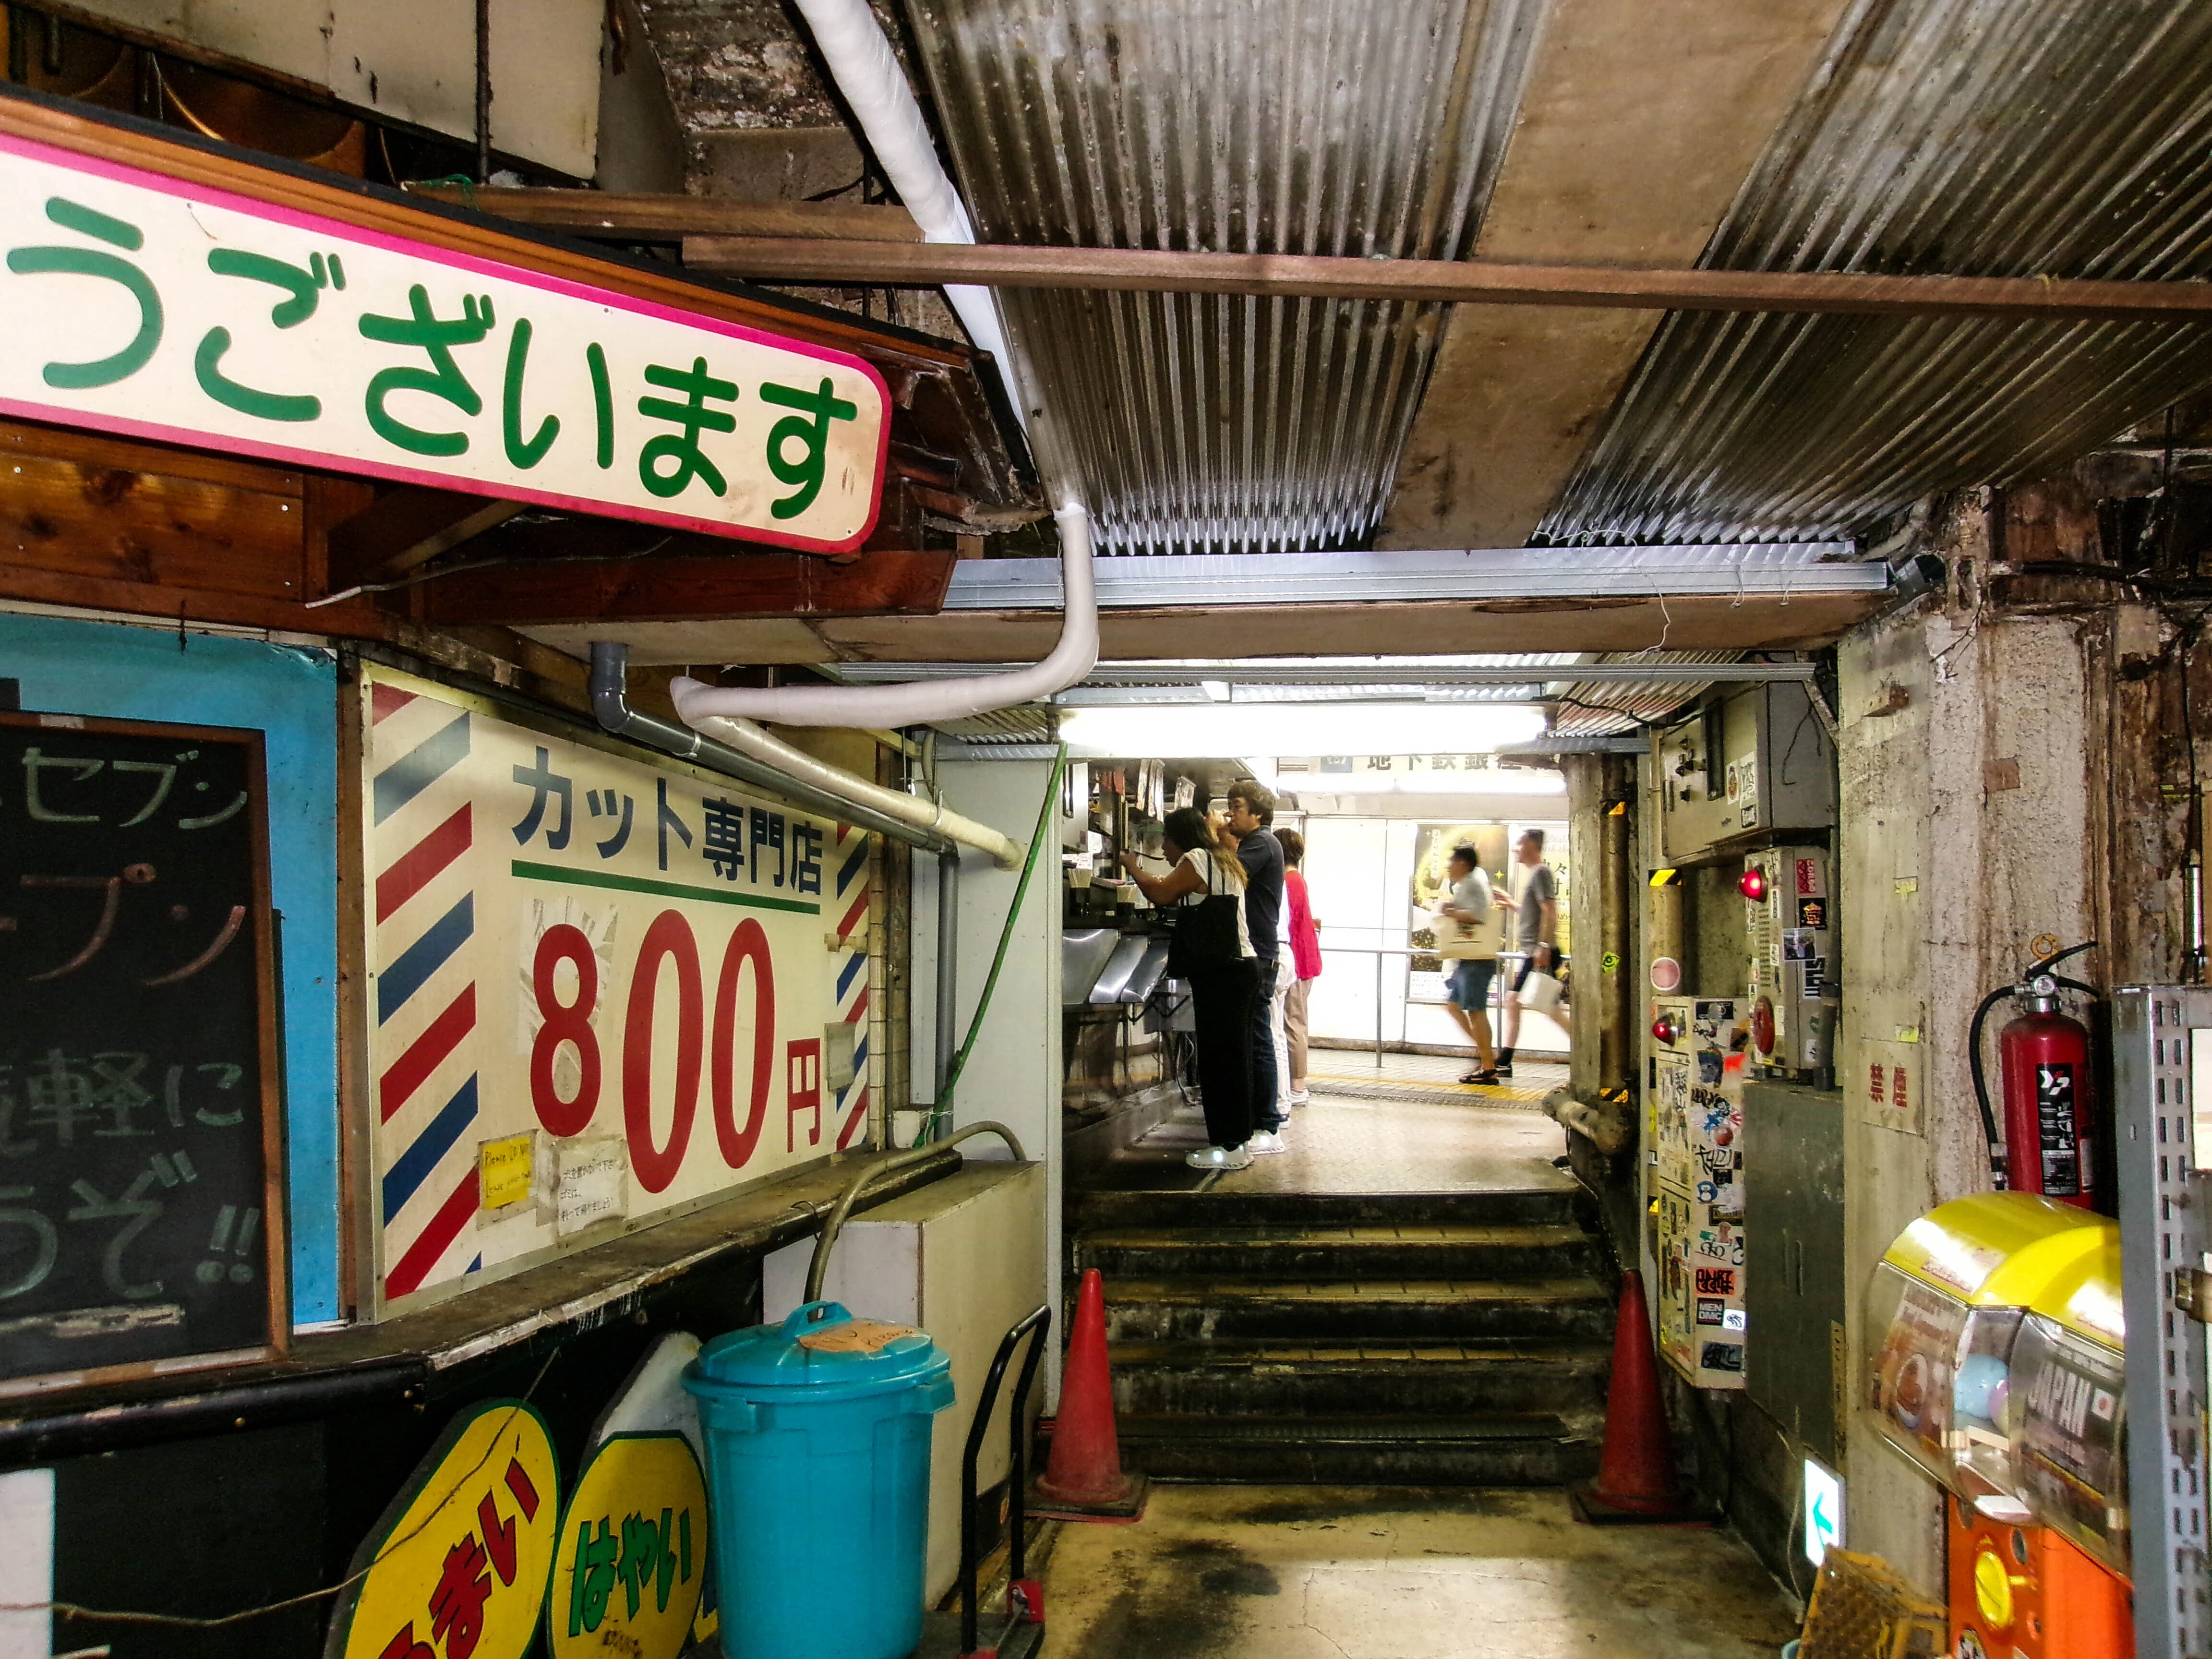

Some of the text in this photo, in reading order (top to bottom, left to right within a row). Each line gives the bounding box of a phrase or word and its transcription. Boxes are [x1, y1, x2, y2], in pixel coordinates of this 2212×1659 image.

[5, 194, 858, 520] うございます
[512, 746, 823, 896] カット専門店
[0, 863, 246, 986] プン
[529, 908, 821, 1194] 800円
[568, 1506, 692, 1637] はやい
